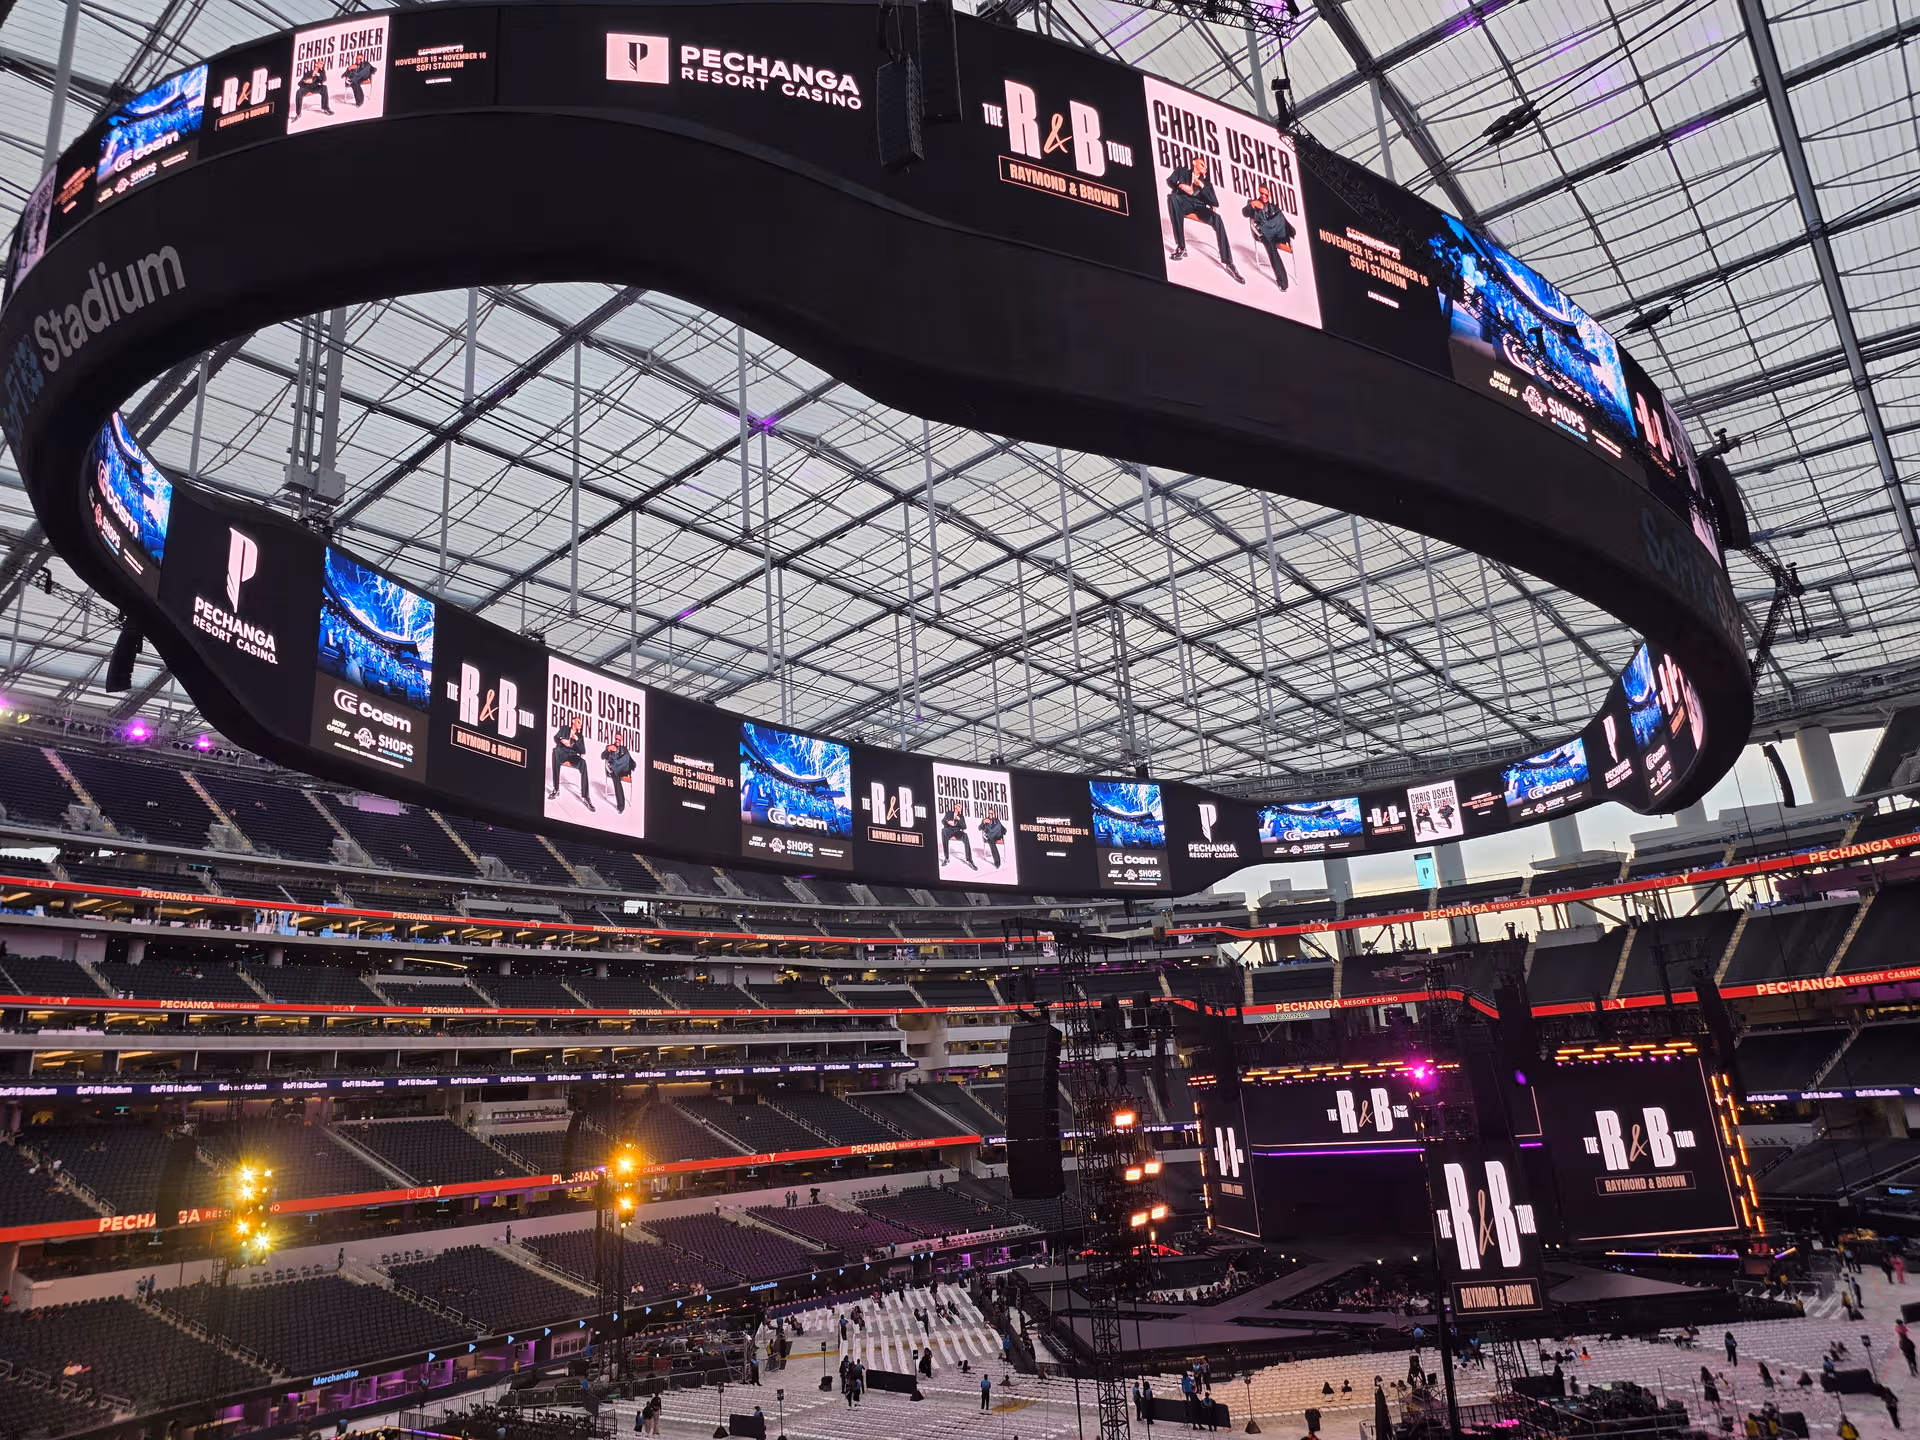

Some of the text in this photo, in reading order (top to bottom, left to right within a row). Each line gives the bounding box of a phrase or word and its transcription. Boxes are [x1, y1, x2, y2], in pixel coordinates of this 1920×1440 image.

[298, 27, 384, 61] CHRIS USHER
[395, 57, 428, 67] NOVEMBER
[430, 55, 438, 64] 15
[443, 53, 478, 62] NOVEMBER
[432, 60, 464, 70] STADIUM
[681, 45, 860, 95] PECHANGA
[681, 66, 862, 110] RESORT CASINO
[982, 103, 1003, 128] THE
[1105, 140, 1133, 168] TOUR
[1153, 99, 1293, 186] CHRIS USHER
[1009, 163, 1120, 209] RAYMOND & BROWN
[1319, 229, 1429, 287] NOVEMBER 15 NOVEMBER 16
[1350, 255, 1408, 290] SOFI STADIUM
[34, 245, 186, 372] Stadium
[1489, 378, 1509, 394] OPEN
[1493, 370, 1511, 385] NOW
[1547, 397, 1586, 433] SHOPS
[195, 596, 276, 652] PECHANGA
[193, 616, 276, 664] RESORT CASINO
[447, 681, 460, 702] THE
[552, 673, 640, 730] CHRIS USHER
[378, 734, 414, 757] SHOPS
[457, 730, 490, 754] RAYMOND
[497, 743, 522, 763] BROWN
[653, 760, 734, 788] NOVEMBER 15 NOVEMBER 16
[672, 776, 716, 795] SOFI STADIUM
[937, 775, 1007, 803] CHRIS USHER
[787, 840, 814, 853] SHOPS
[1188, 843, 1237, 853] PECHANGA
[1808, 841, 1893, 863] PECHANGA
[1138, 869, 1162, 878] SHOPS
[141, 890, 193, 902] PECHANGA
[393, 912, 433, 921] PECHANGA
[1422, 897, 1548, 920] PECHANGA RESORT CASINO
[1757, 968, 1920, 995] PECHANGA RESORT CASINO
[160, 1000, 215, 1010] PECHANGA
[422, 1006, 464, 1015] PECHANGA
[1275, 995, 1398, 1013] PECHANGA RESORT CASINO
[1326, 1109, 1338, 1122] THE
[851, 1141, 897, 1154] PECHANGA
[917, 1139, 936, 1147] CASINO
[1583, 1136, 1600, 1154] THE
[1673, 1130, 1696, 1148] TOUR
[642, 1166, 665, 1174] CASINO
[1604, 1177, 1647, 1192] RAYMOND
[1655, 1174, 1687, 1188] BROWN
[99, 1209, 201, 1232] PECHGA
[1436, 1209, 1453, 1239] THE
[1514, 1204, 1537, 1234] TOUR
[1460, 1286, 1499, 1309] RAYMOND
[1504, 1284, 1534, 1306] BROWN
[313, 1369, 359, 1386] Merchandise
